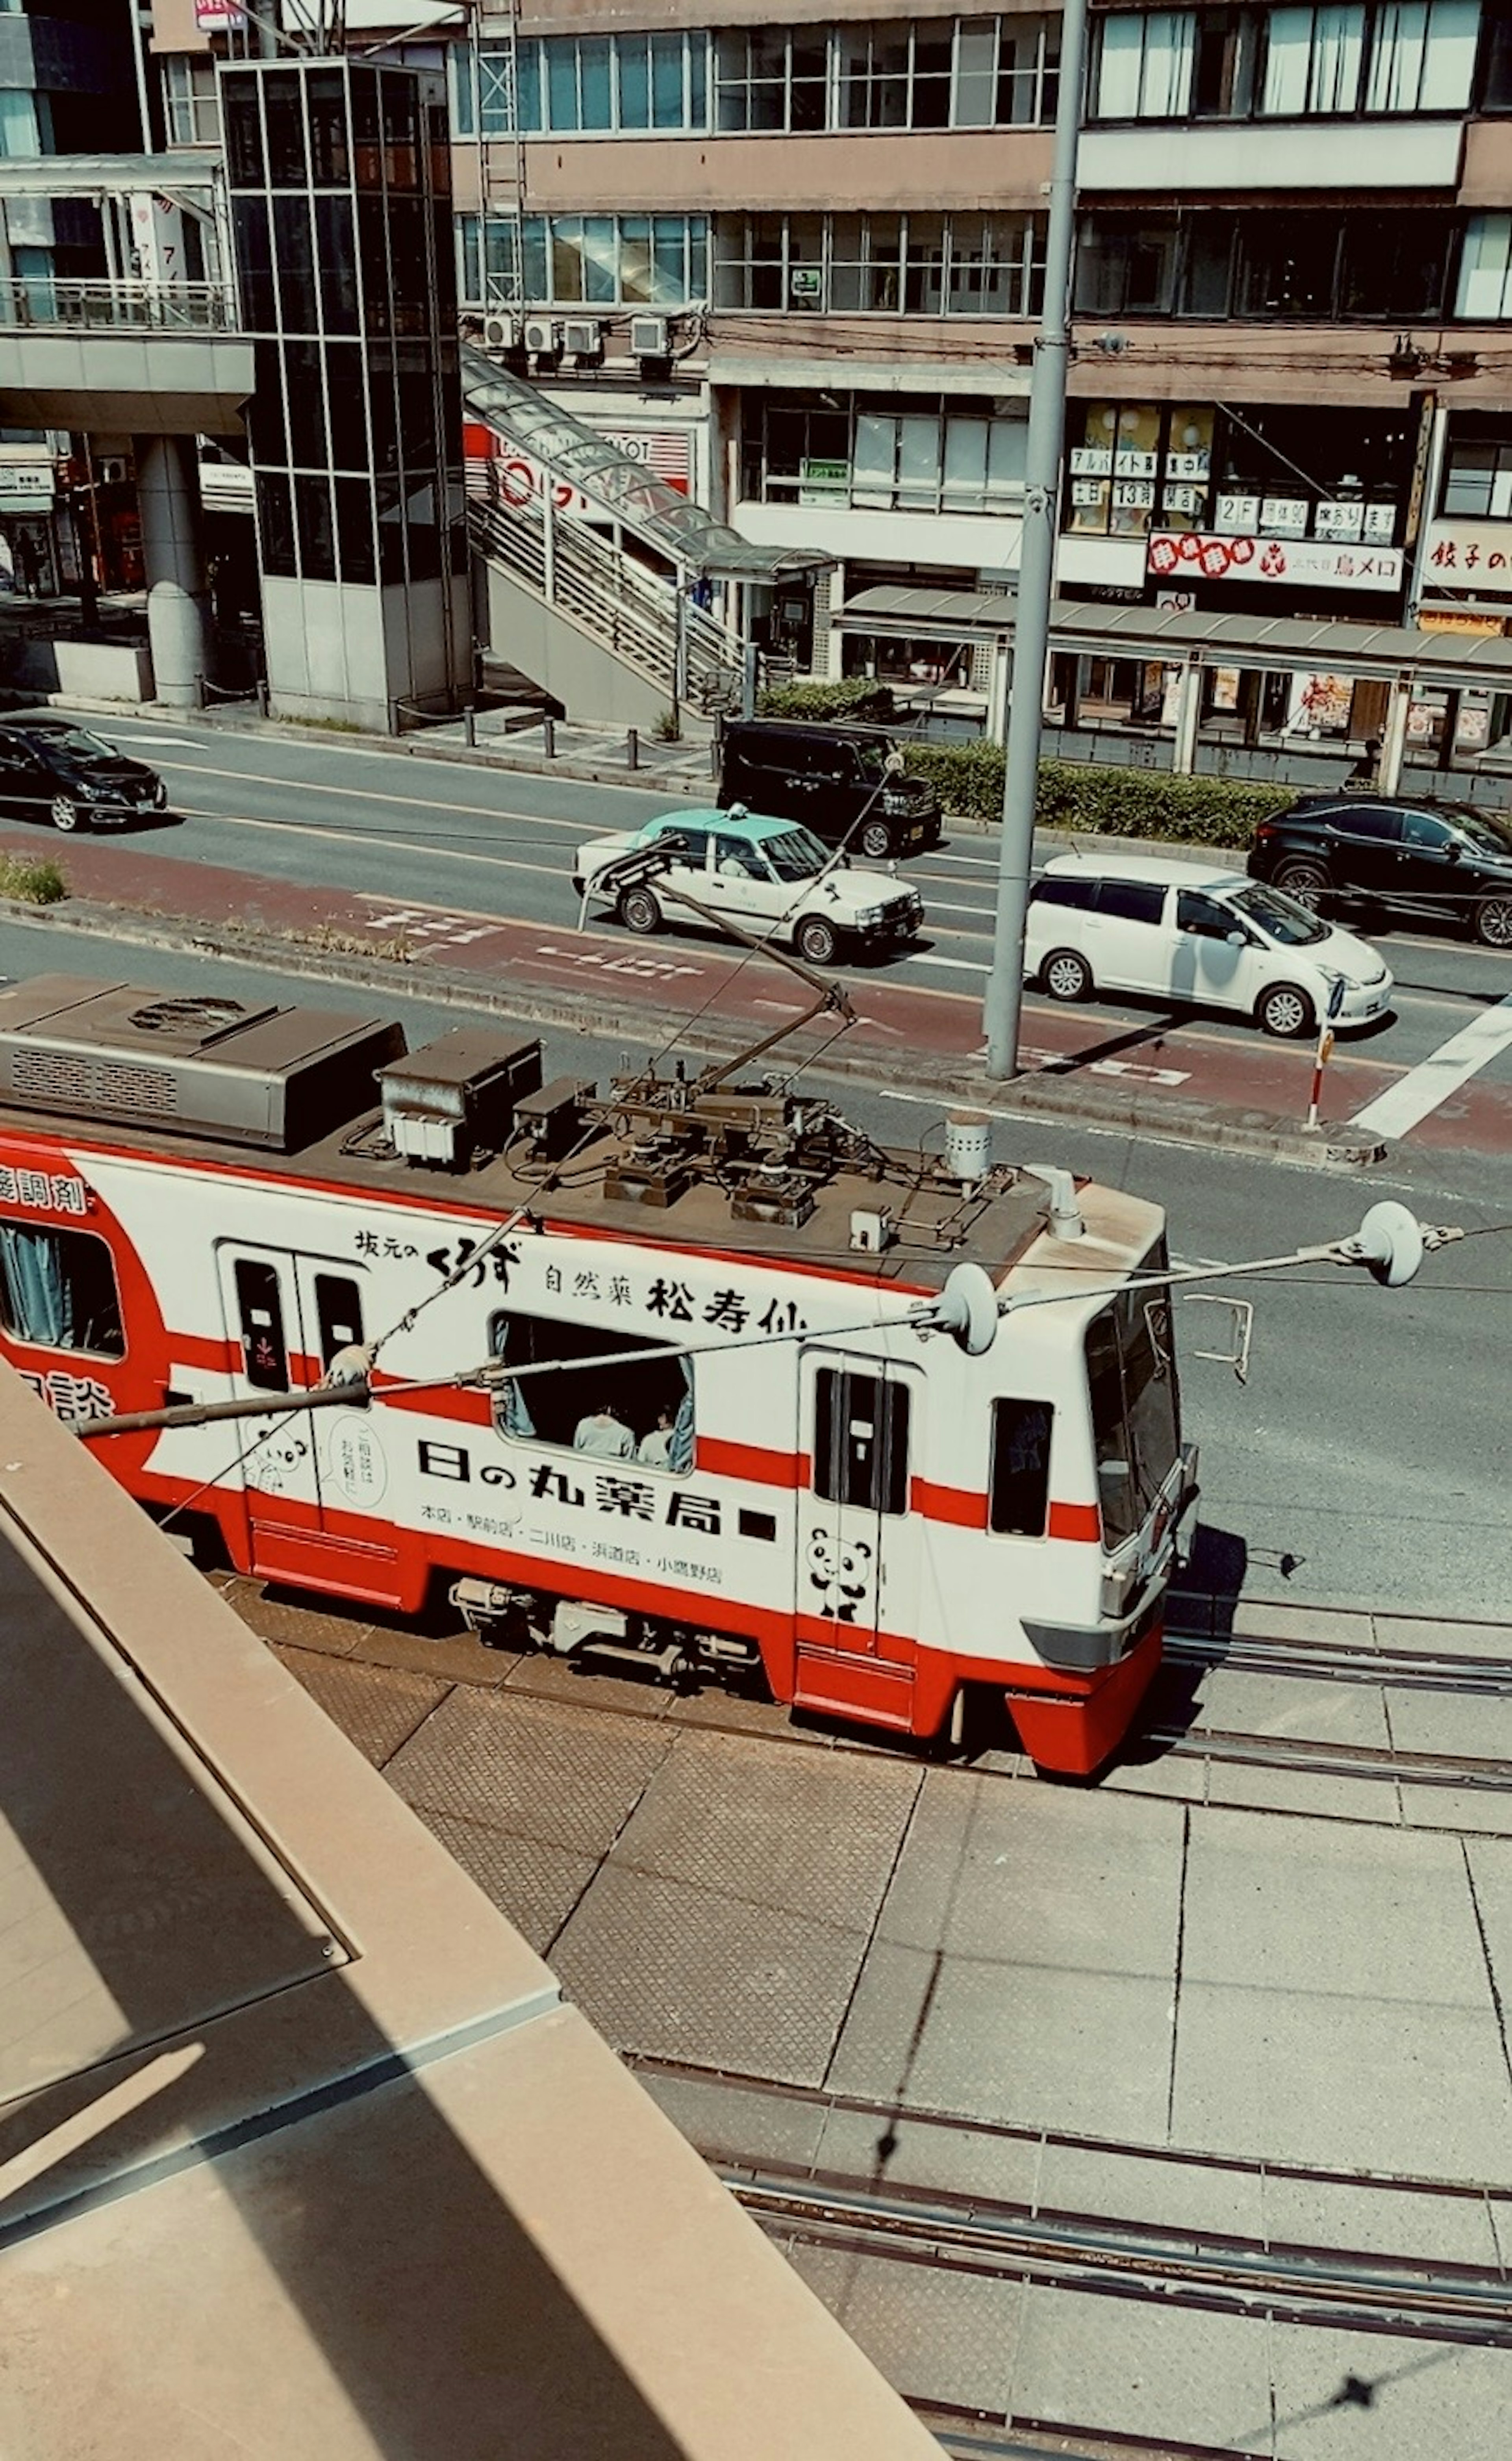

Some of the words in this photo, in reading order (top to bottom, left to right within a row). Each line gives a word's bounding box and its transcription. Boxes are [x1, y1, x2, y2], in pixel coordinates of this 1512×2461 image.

[354, 1230, 419, 1259] 坂元の
[646, 1278, 807, 1334] 松寿仙
[19, 1373, 111, 1420] 談
[418, 1439, 721, 1535] 日の丸薬局
